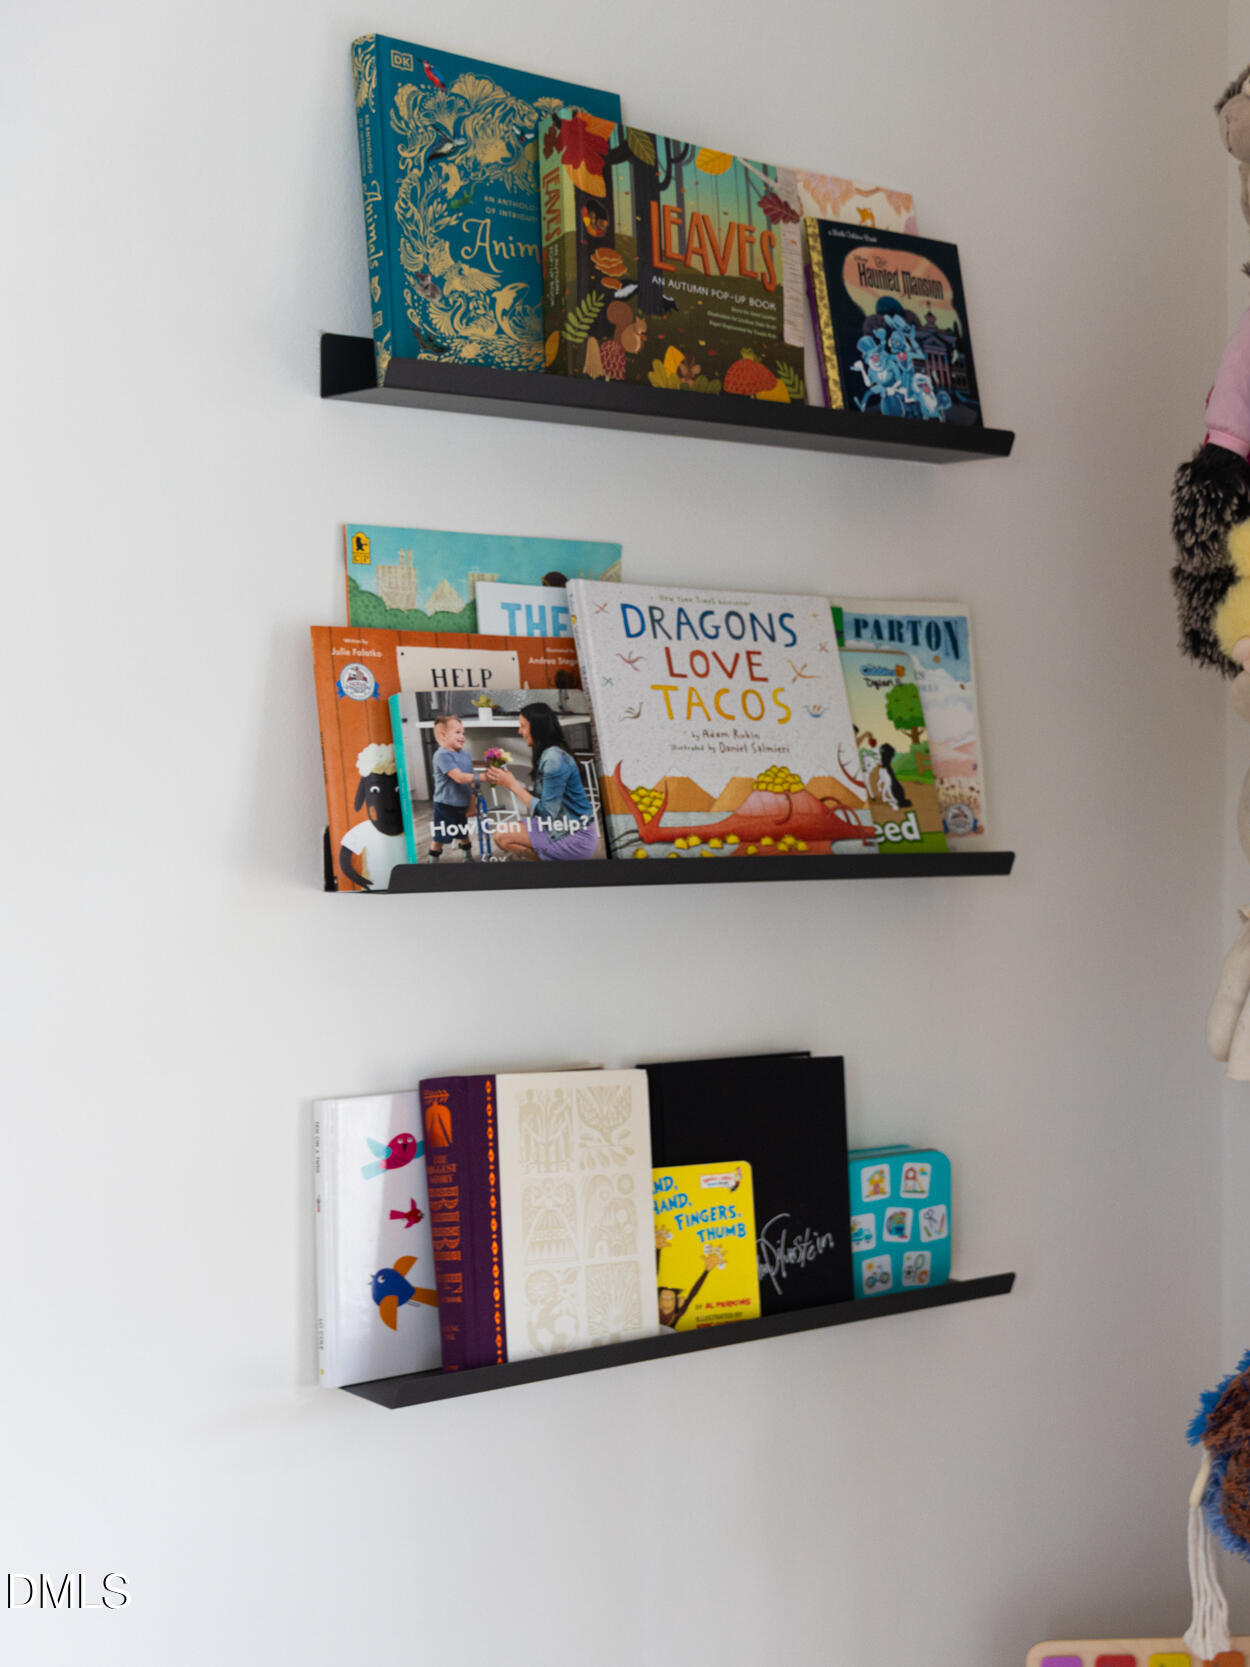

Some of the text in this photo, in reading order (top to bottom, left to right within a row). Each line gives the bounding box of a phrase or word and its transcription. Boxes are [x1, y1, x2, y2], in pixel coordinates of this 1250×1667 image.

[394, 54, 410, 67] DK
[542, 166, 562, 243] LEAVES
[364, 179, 384, 270] Animals
[650, 200, 777, 293] LEAVES
[651, 275, 777, 312] AN AUTUMN POP-UP BOOK
[857, 262, 944, 299] Haunted Mansion
[620, 603, 798, 648] DRAGONS
[853, 618, 960, 660] PARTON
[332, 648, 351, 656] Julie
[664, 646, 769, 682] LOVE
[431, 668, 492, 688] HELP
[650, 684, 792, 724] TACOS
[702, 728, 729, 739] Adam
[732, 728, 761, 740] Rubin
[719, 742, 748, 754] Daniel
[751, 742, 790, 755] Salmieri
[429, 815, 589, 837] How Can I Help?
[696, 1223, 747, 1244] THUMB
